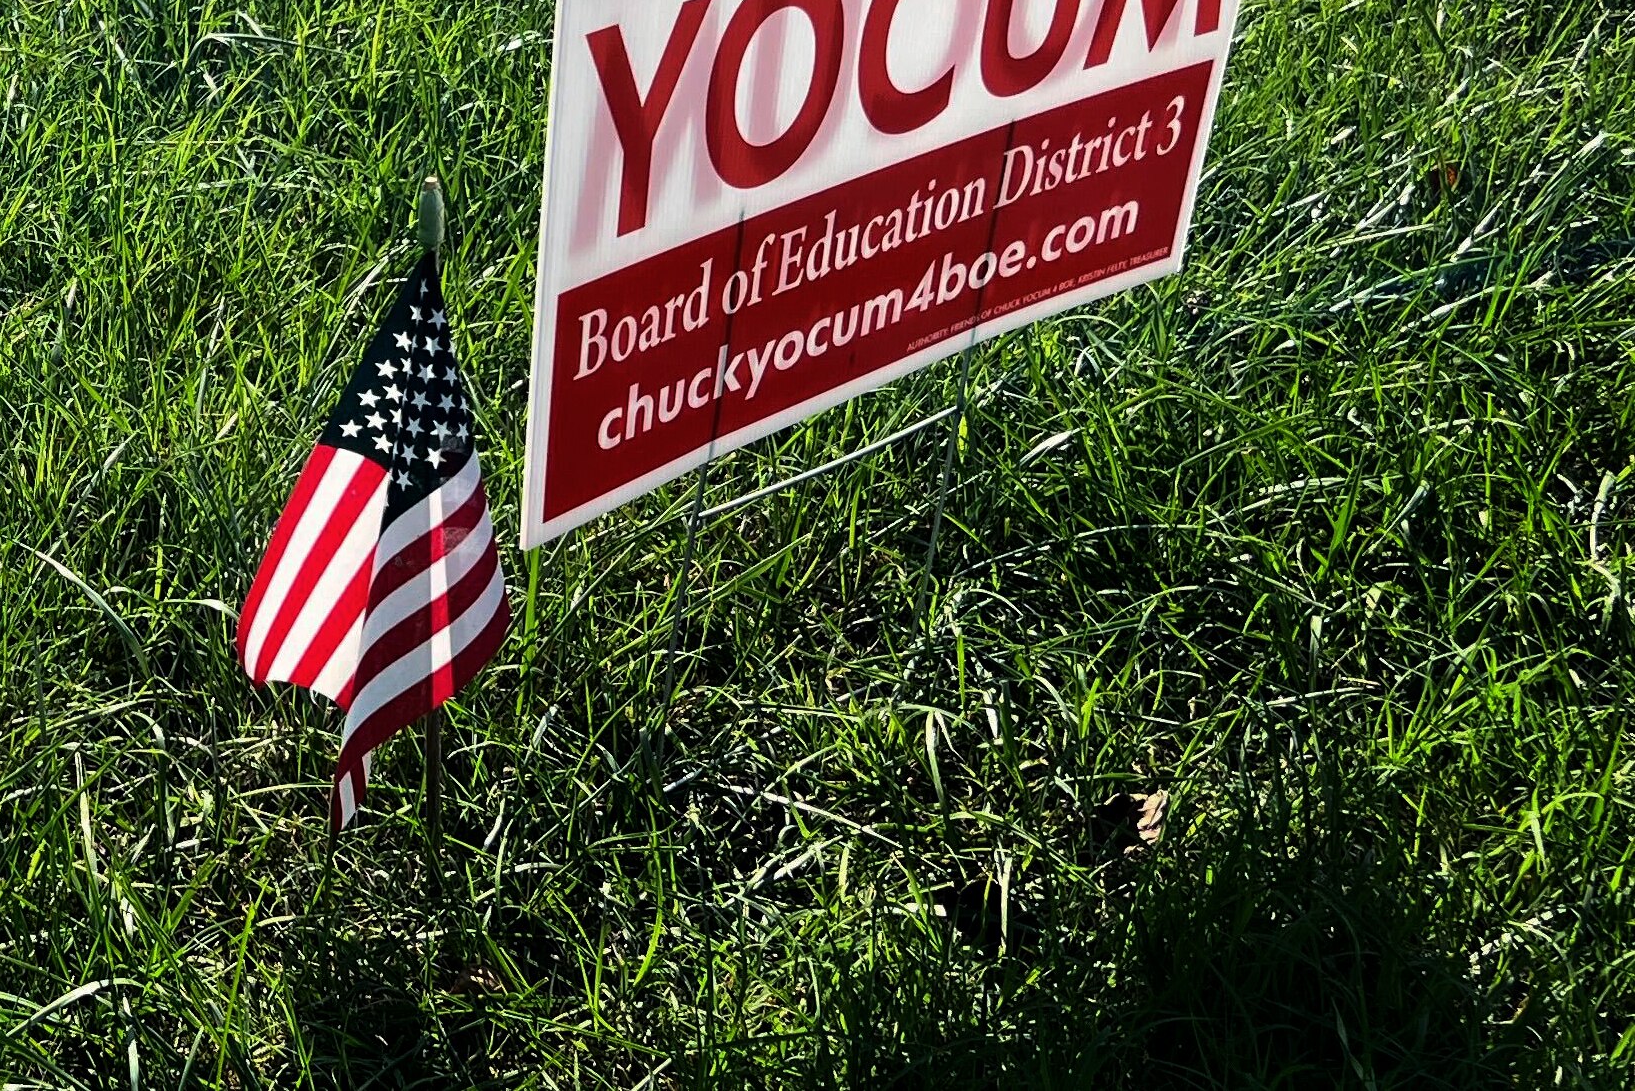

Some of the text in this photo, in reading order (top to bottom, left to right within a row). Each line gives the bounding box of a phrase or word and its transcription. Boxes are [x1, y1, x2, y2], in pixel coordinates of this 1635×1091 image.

[573, 94, 1186, 381] Board of Education District 3
[597, 200, 1140, 450] chuckyocum4boe.com
[981, 309, 992, 320] OF
[994, 301, 1021, 314] CHUCK
[1023, 287, 1051, 304] YOCUM
